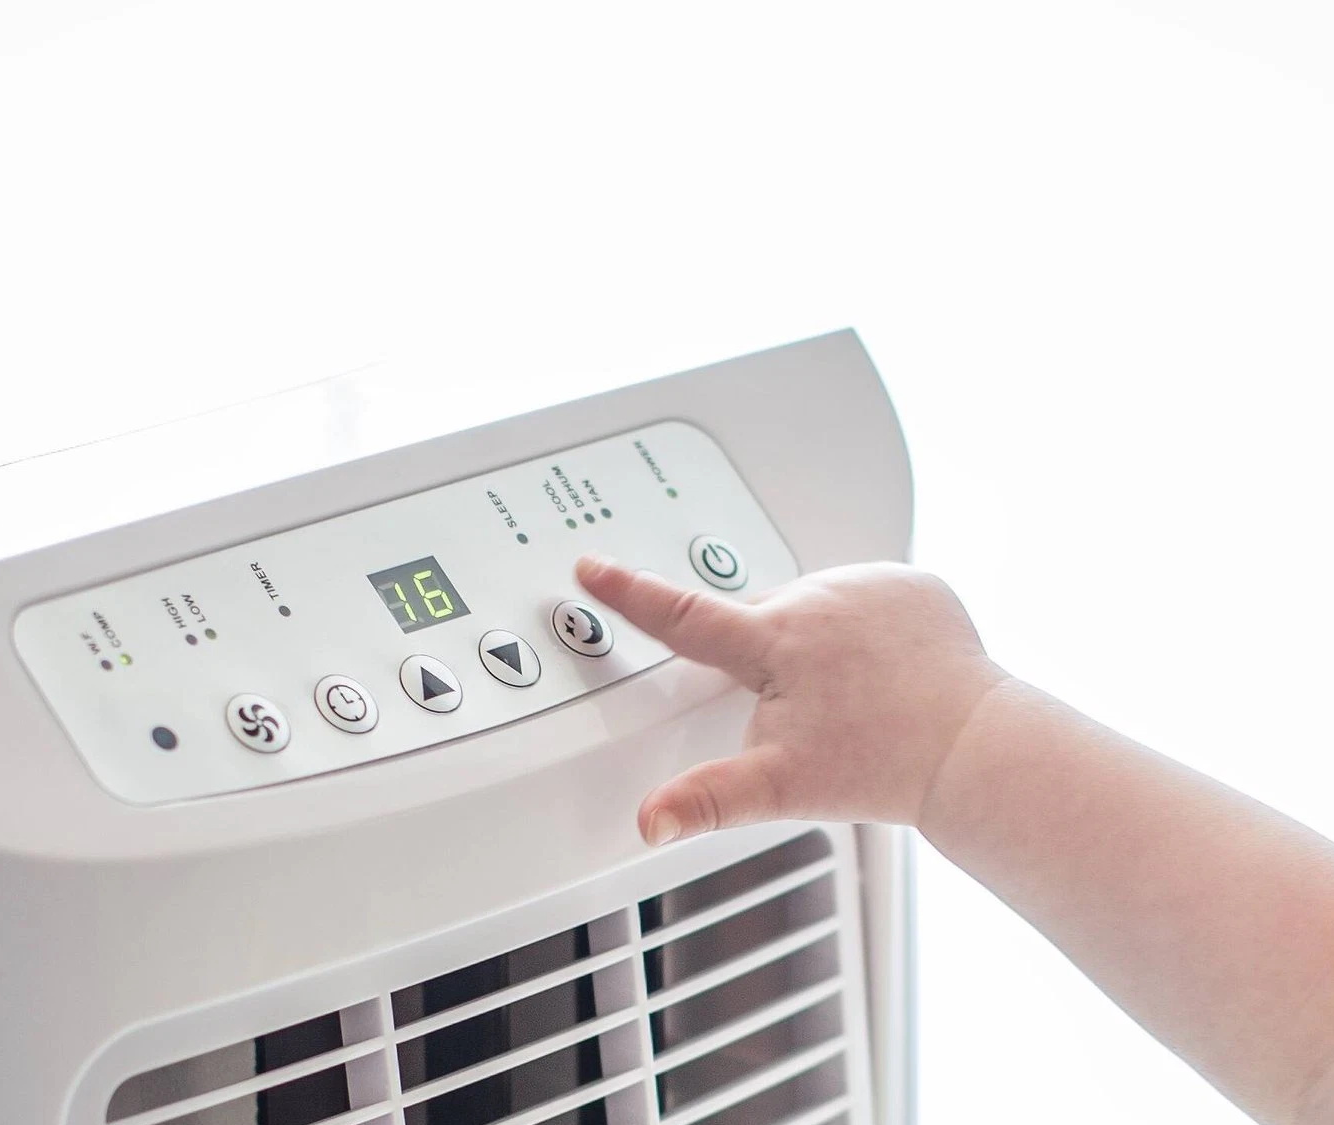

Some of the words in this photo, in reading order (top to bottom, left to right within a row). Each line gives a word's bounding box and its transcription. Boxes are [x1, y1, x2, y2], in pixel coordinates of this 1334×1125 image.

[633, 440, 667, 484] POWER
[542, 479, 568, 513] COOL
[551, 465, 585, 508] DEHUM
[581, 479, 602, 503] FAN
[486, 490, 517, 529] SLEEP
[250, 561, 280, 601] TIMER
[394, 569, 454, 623] 16
[161, 597, 187, 629] HIGH
[181, 594, 207, 623] LOW
[92, 611, 122, 649] COMP
